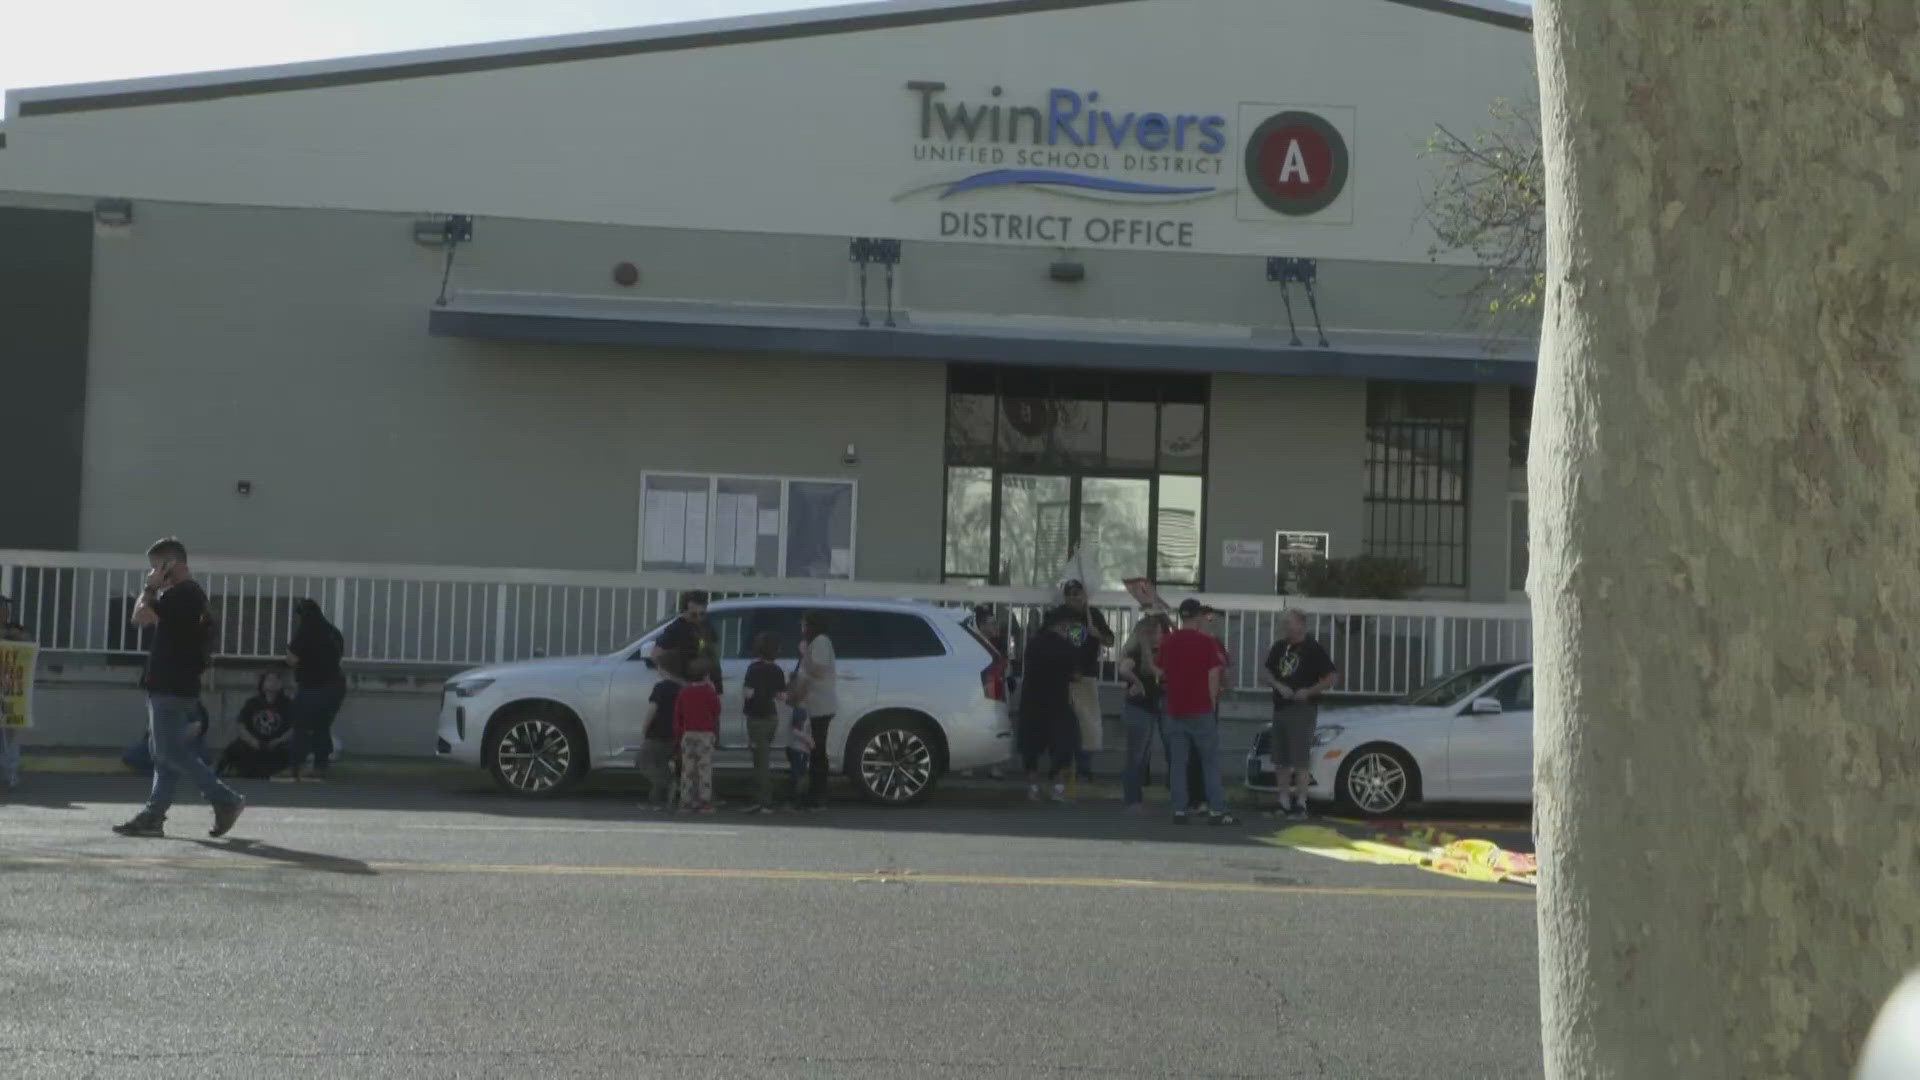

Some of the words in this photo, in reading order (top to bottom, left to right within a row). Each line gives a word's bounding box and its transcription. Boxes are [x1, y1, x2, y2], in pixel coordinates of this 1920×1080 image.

[913, 144, 1004, 165] UNIFIED
[1016, 149, 1110, 170] SCHOOL
[1123, 154, 1224, 175] DISTRICT
[1279, 139, 1310, 184] A
[939, 211, 1073, 242] DISTRICT
[1084, 217, 1194, 247] OFFICE
